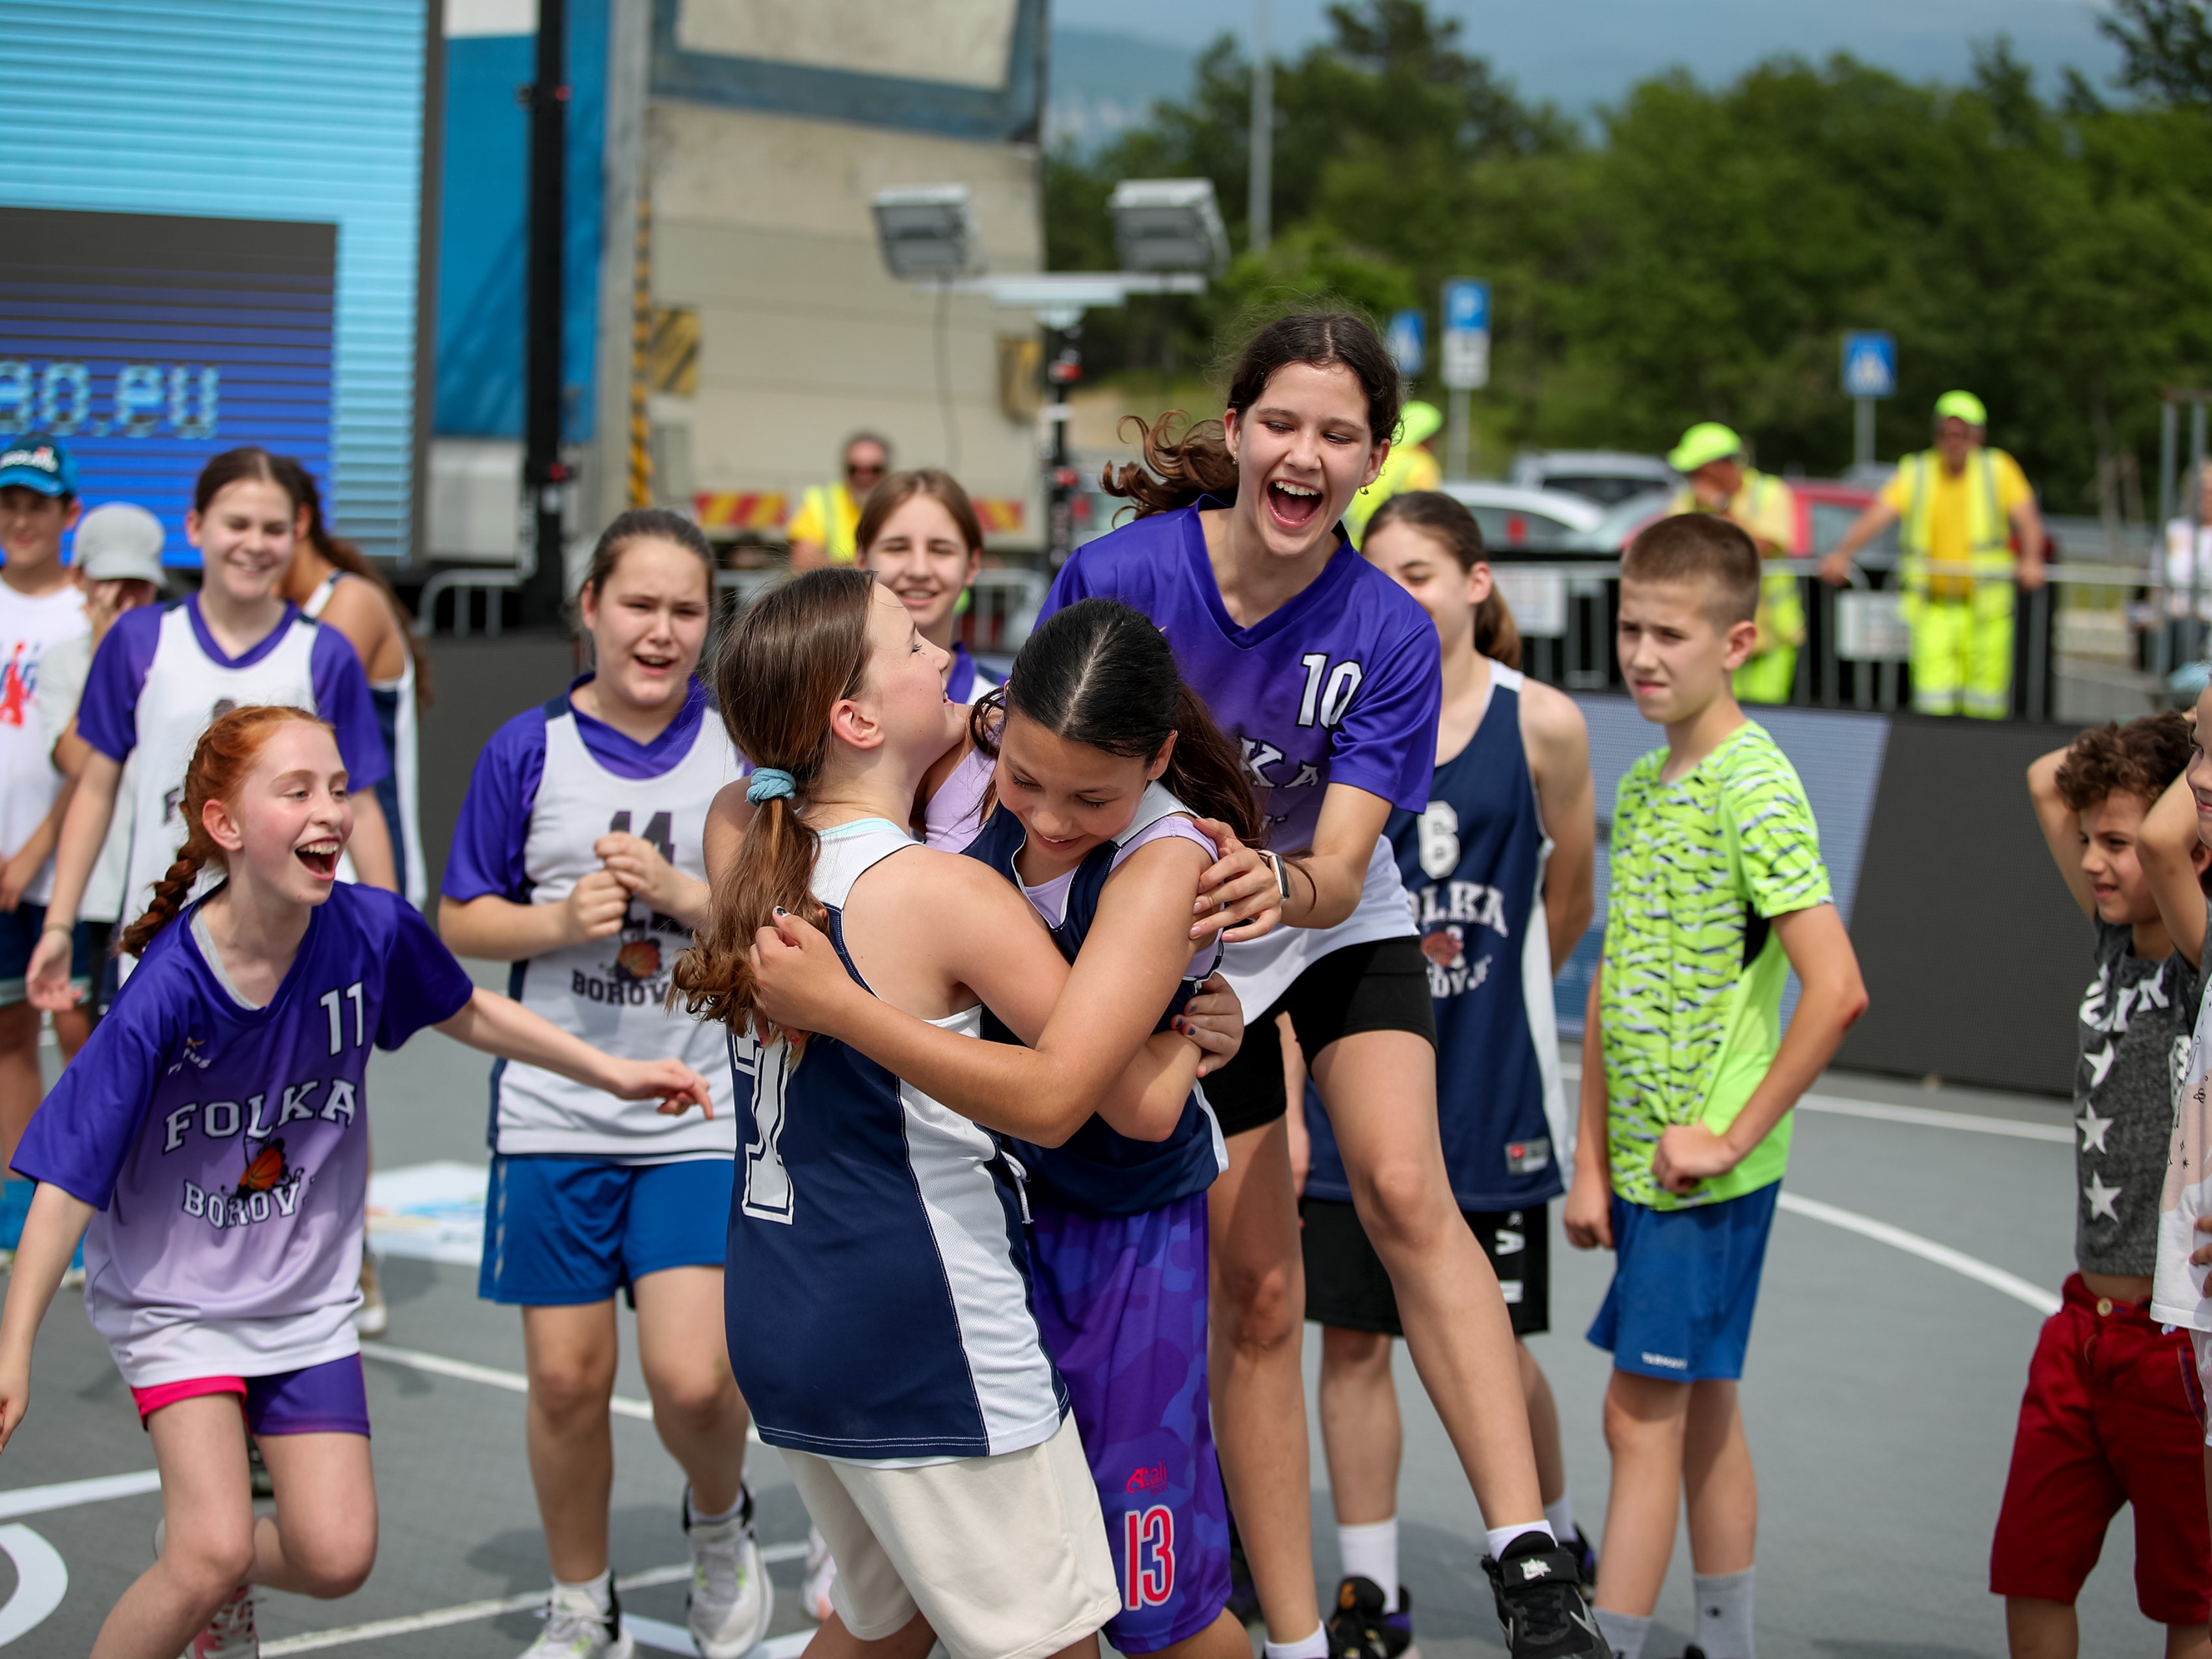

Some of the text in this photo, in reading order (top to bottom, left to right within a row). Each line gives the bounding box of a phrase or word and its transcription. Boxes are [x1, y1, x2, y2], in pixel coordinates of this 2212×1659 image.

[1296, 651, 1364, 729] 10
[1417, 800, 1460, 880] 6
[318, 980, 366, 1057] 11
[572, 968, 670, 1007] BOROV
[163, 1078, 357, 1155] FOLKA
[181, 1178, 310, 1230] BOROV
[1124, 1504, 1176, 1611] 13
